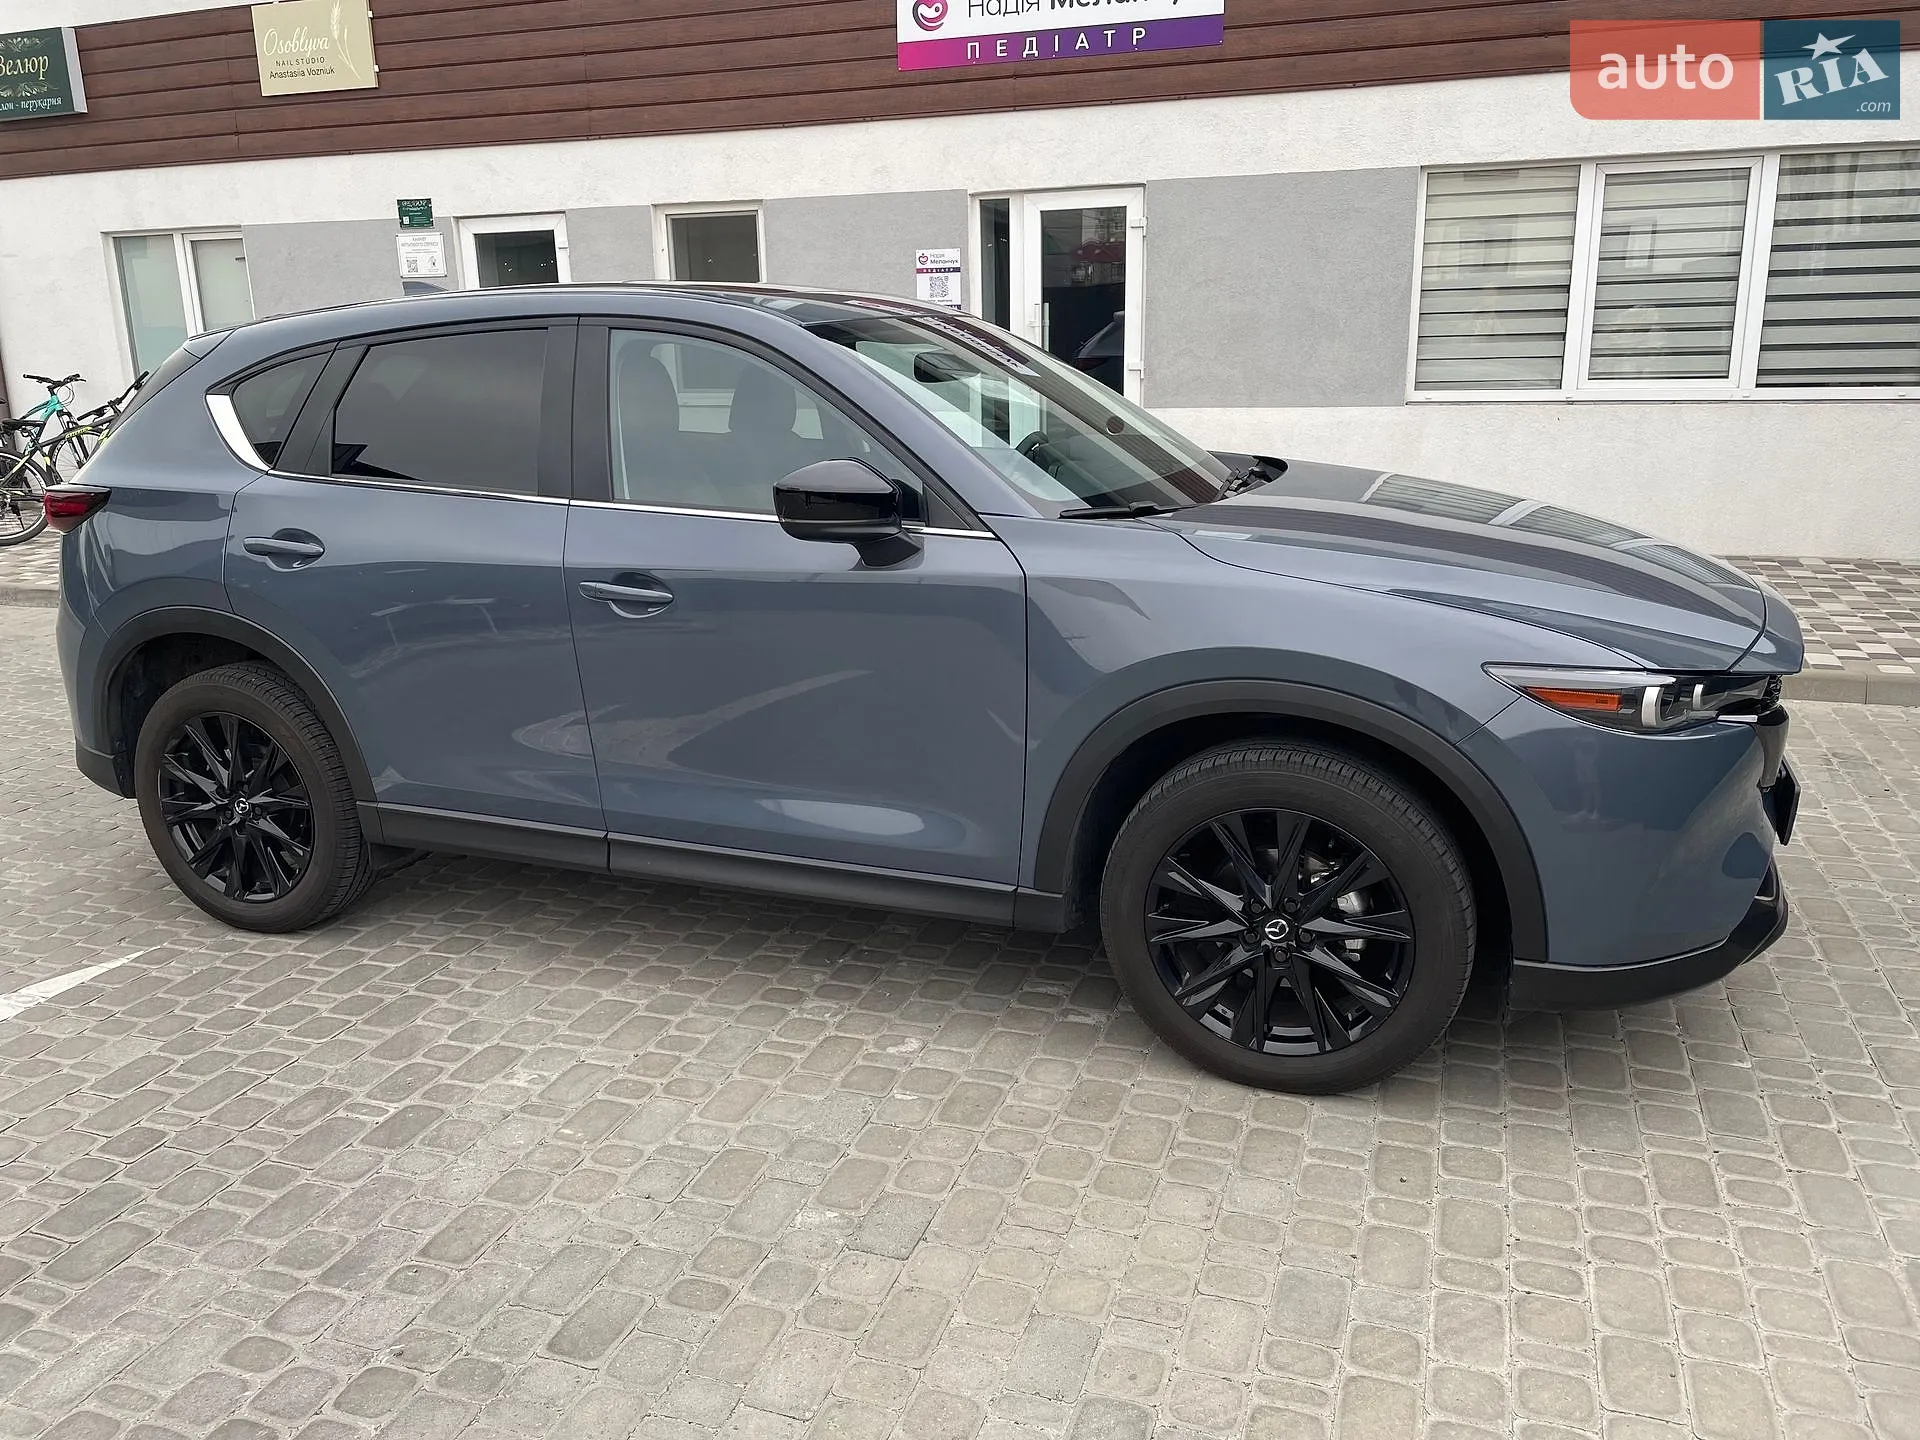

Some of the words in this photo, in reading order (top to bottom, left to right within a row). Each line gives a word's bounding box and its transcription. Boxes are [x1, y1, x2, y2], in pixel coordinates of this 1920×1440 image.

[263, 26, 330, 57] Osoblyva
[967, 27, 1146, 59] ПЕДІАТР
[275, 59, 294, 67] NAIL
[295, 56, 326, 66] STUDIO
[20, 97, 62, 112] перукарня
